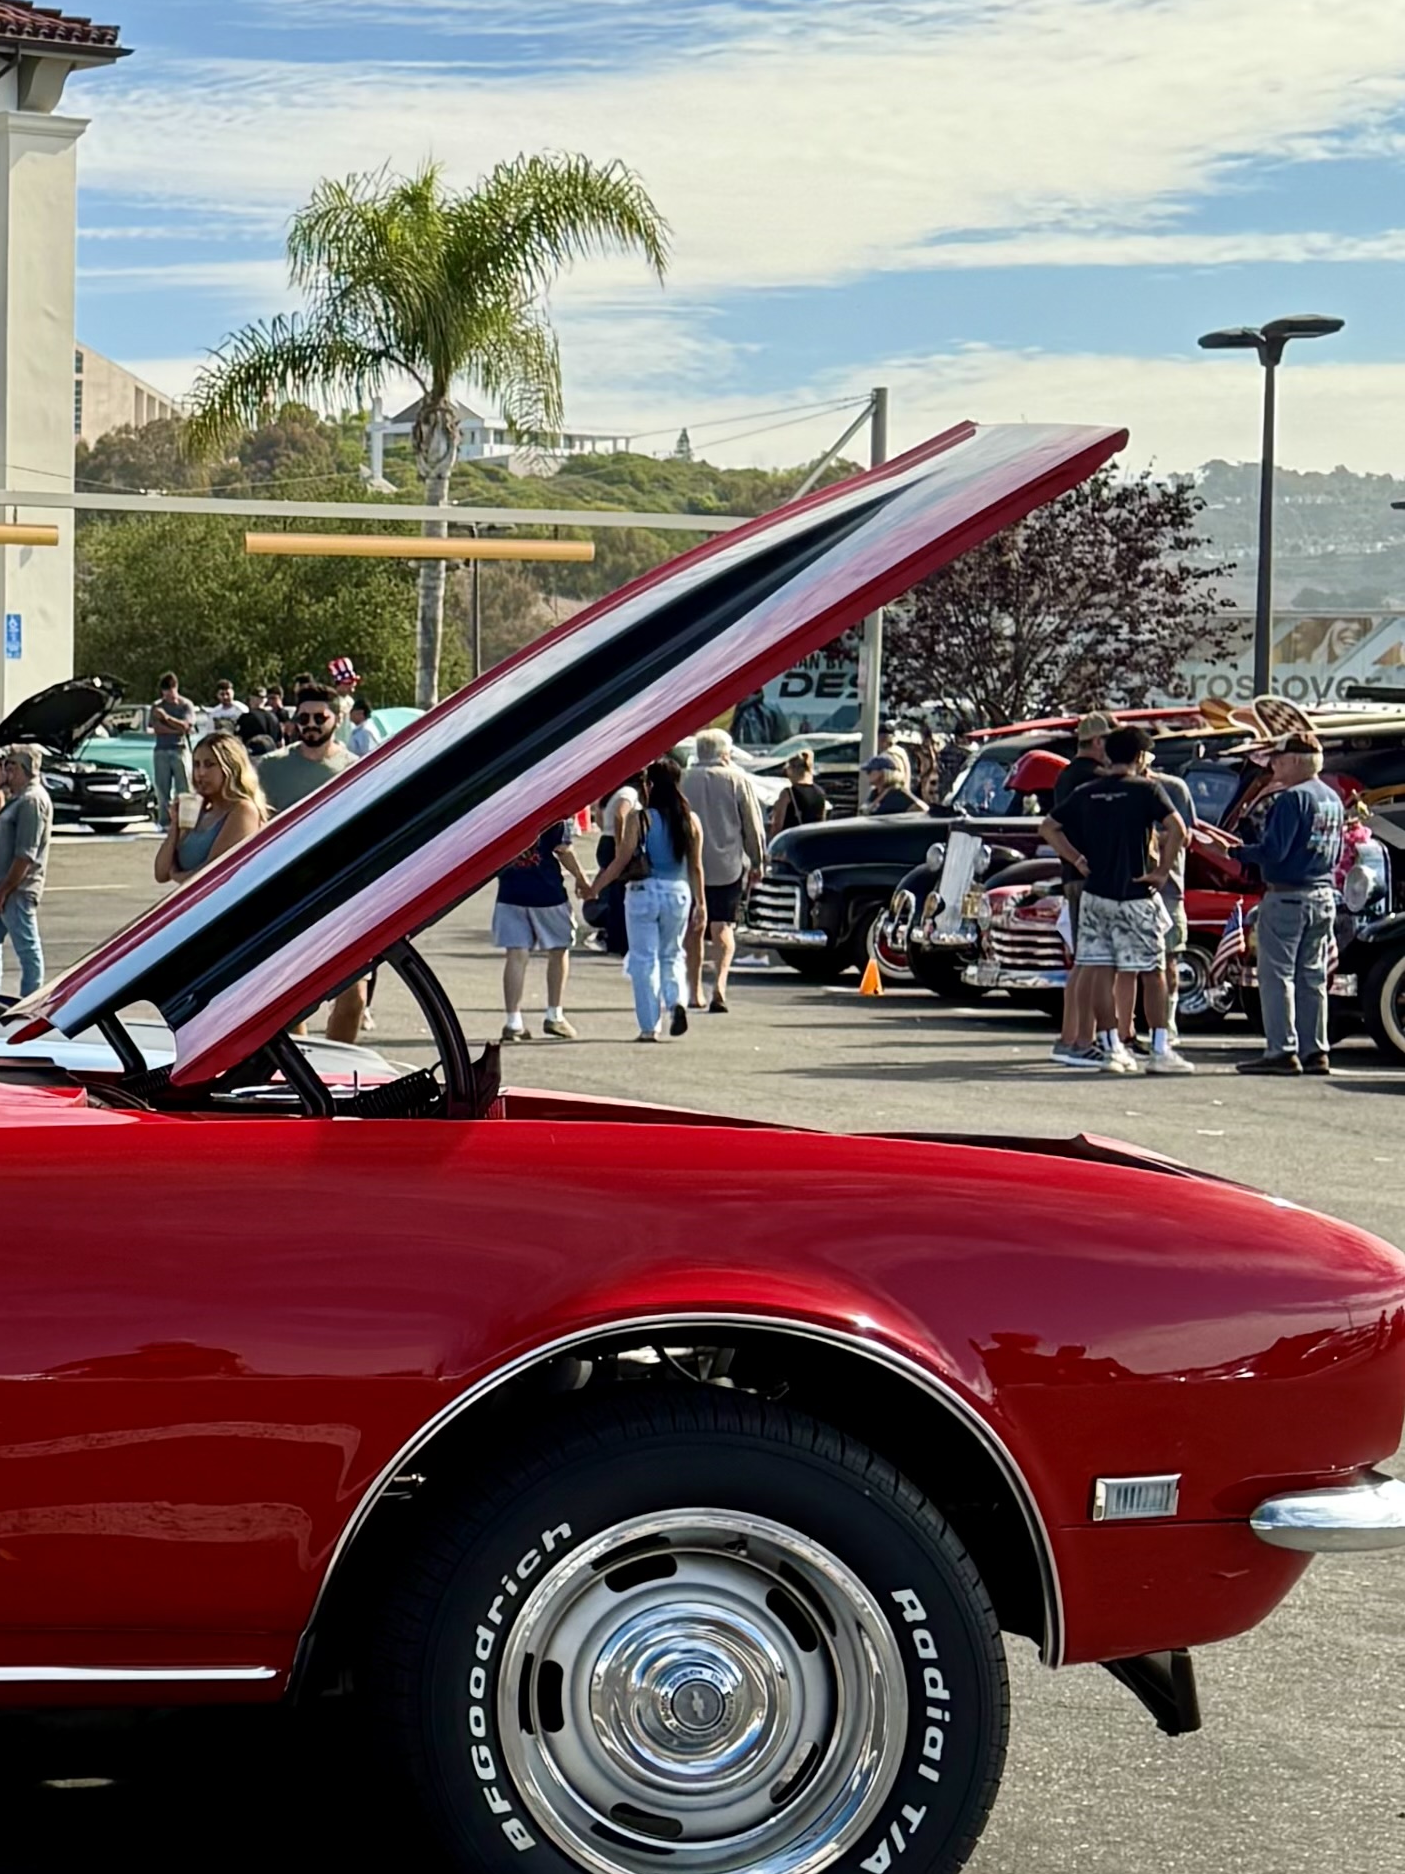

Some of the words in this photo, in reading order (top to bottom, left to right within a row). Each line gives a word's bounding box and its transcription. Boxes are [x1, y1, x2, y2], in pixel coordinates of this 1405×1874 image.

[468, 1522, 573, 1852] BFGoodrich
[891, 1588, 950, 1783] Radial
[860, 1805, 927, 1874] T/A
